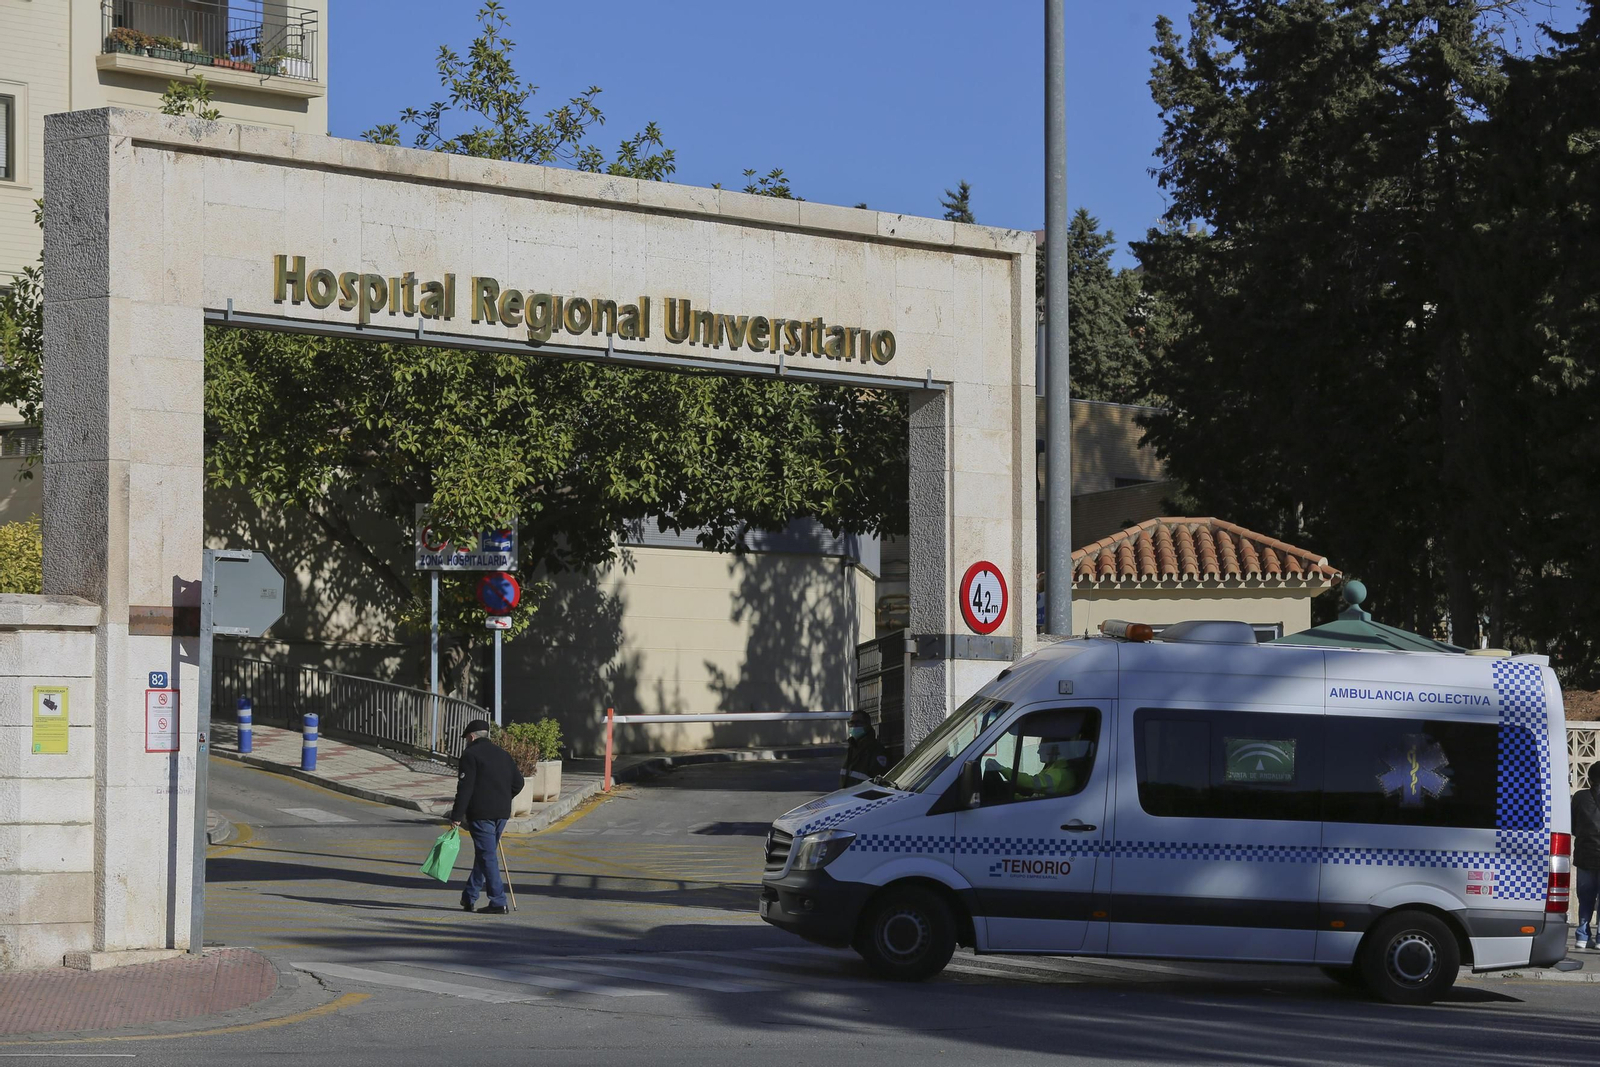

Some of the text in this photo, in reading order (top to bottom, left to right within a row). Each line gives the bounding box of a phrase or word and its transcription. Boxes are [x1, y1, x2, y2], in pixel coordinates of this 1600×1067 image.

[274, 254, 897, 365] Hospital Regional Universitario
[420, 554, 508, 567] ZONA HOSPITALARIA
[151, 673, 164, 686] 82
[1329, 687, 1491, 706] AMBULANCIA COLECTIVA
[1002, 859, 1071, 875] TENORIO
